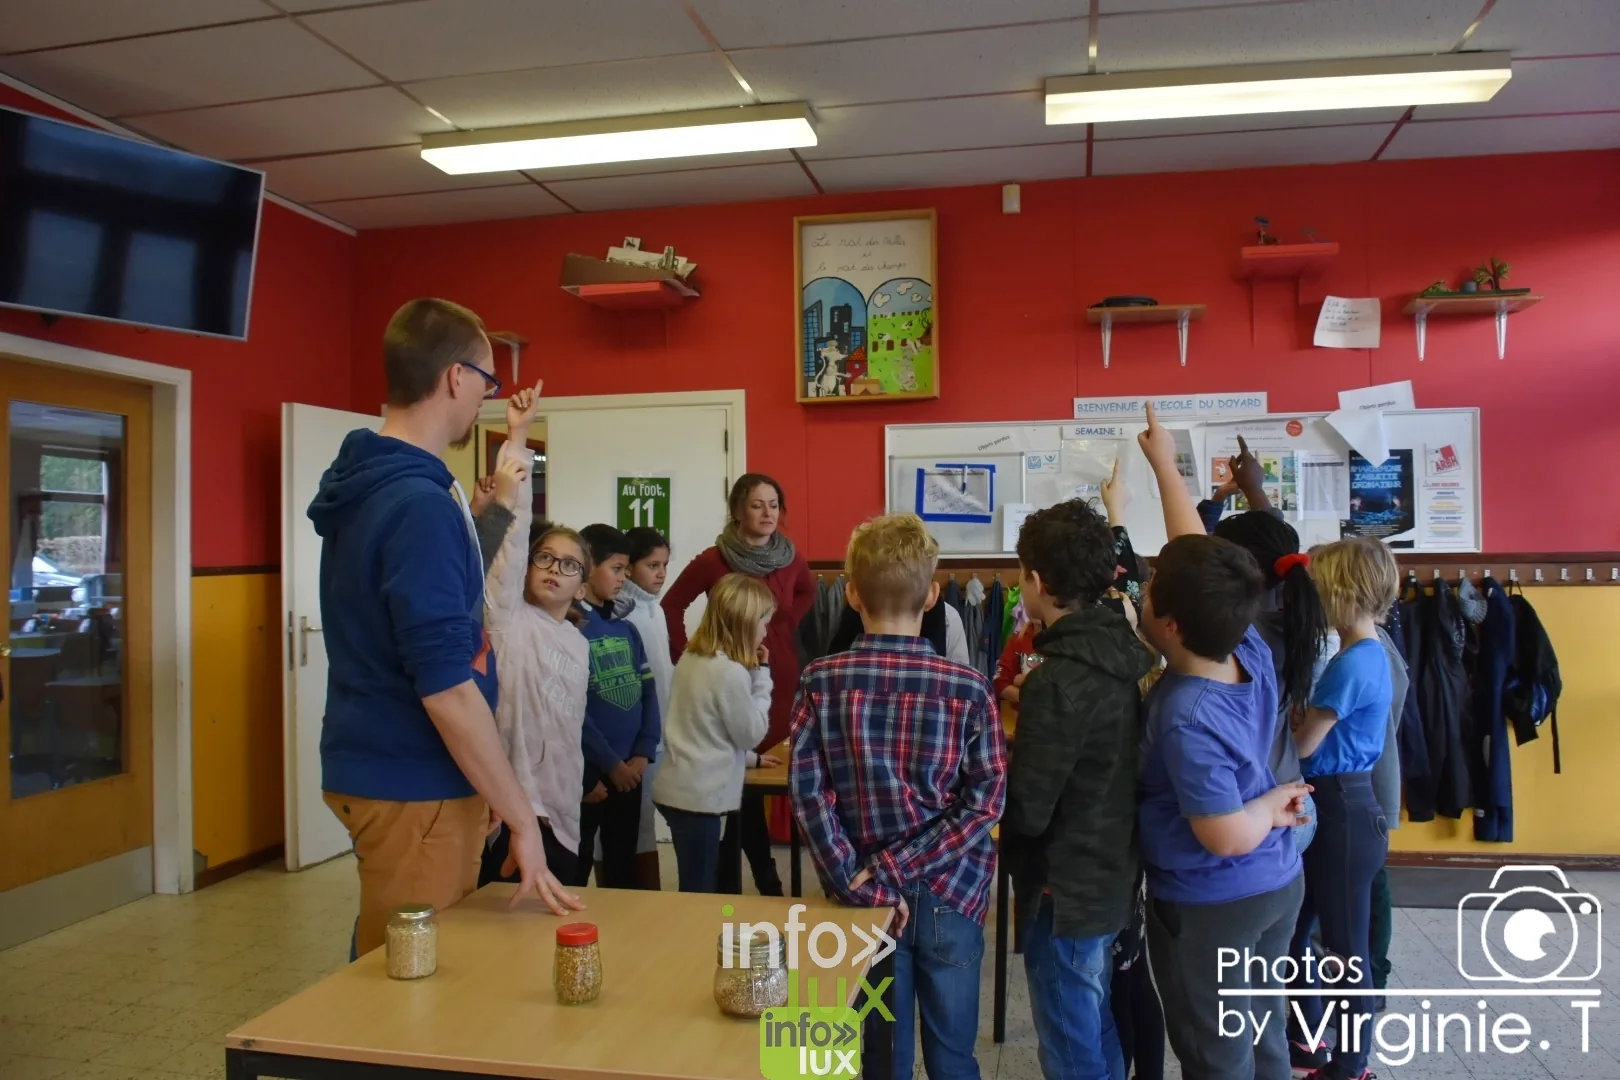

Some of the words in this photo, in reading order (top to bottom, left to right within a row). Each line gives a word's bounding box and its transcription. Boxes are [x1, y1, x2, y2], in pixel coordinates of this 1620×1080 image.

[1077, 401, 1138, 413] BIENVENUE
[1152, 399, 1193, 411] L'ECOLE
[1199, 399, 1214, 409] DU
[1218, 397, 1262, 408] DOYARD
[1075, 427, 1115, 436] SEMAINE
[1119, 427, 1124, 435] 1
[977, 440, 994, 452] Objets
[1075, 484, 1101, 494] SEMA
[629, 498, 655, 528] 11
